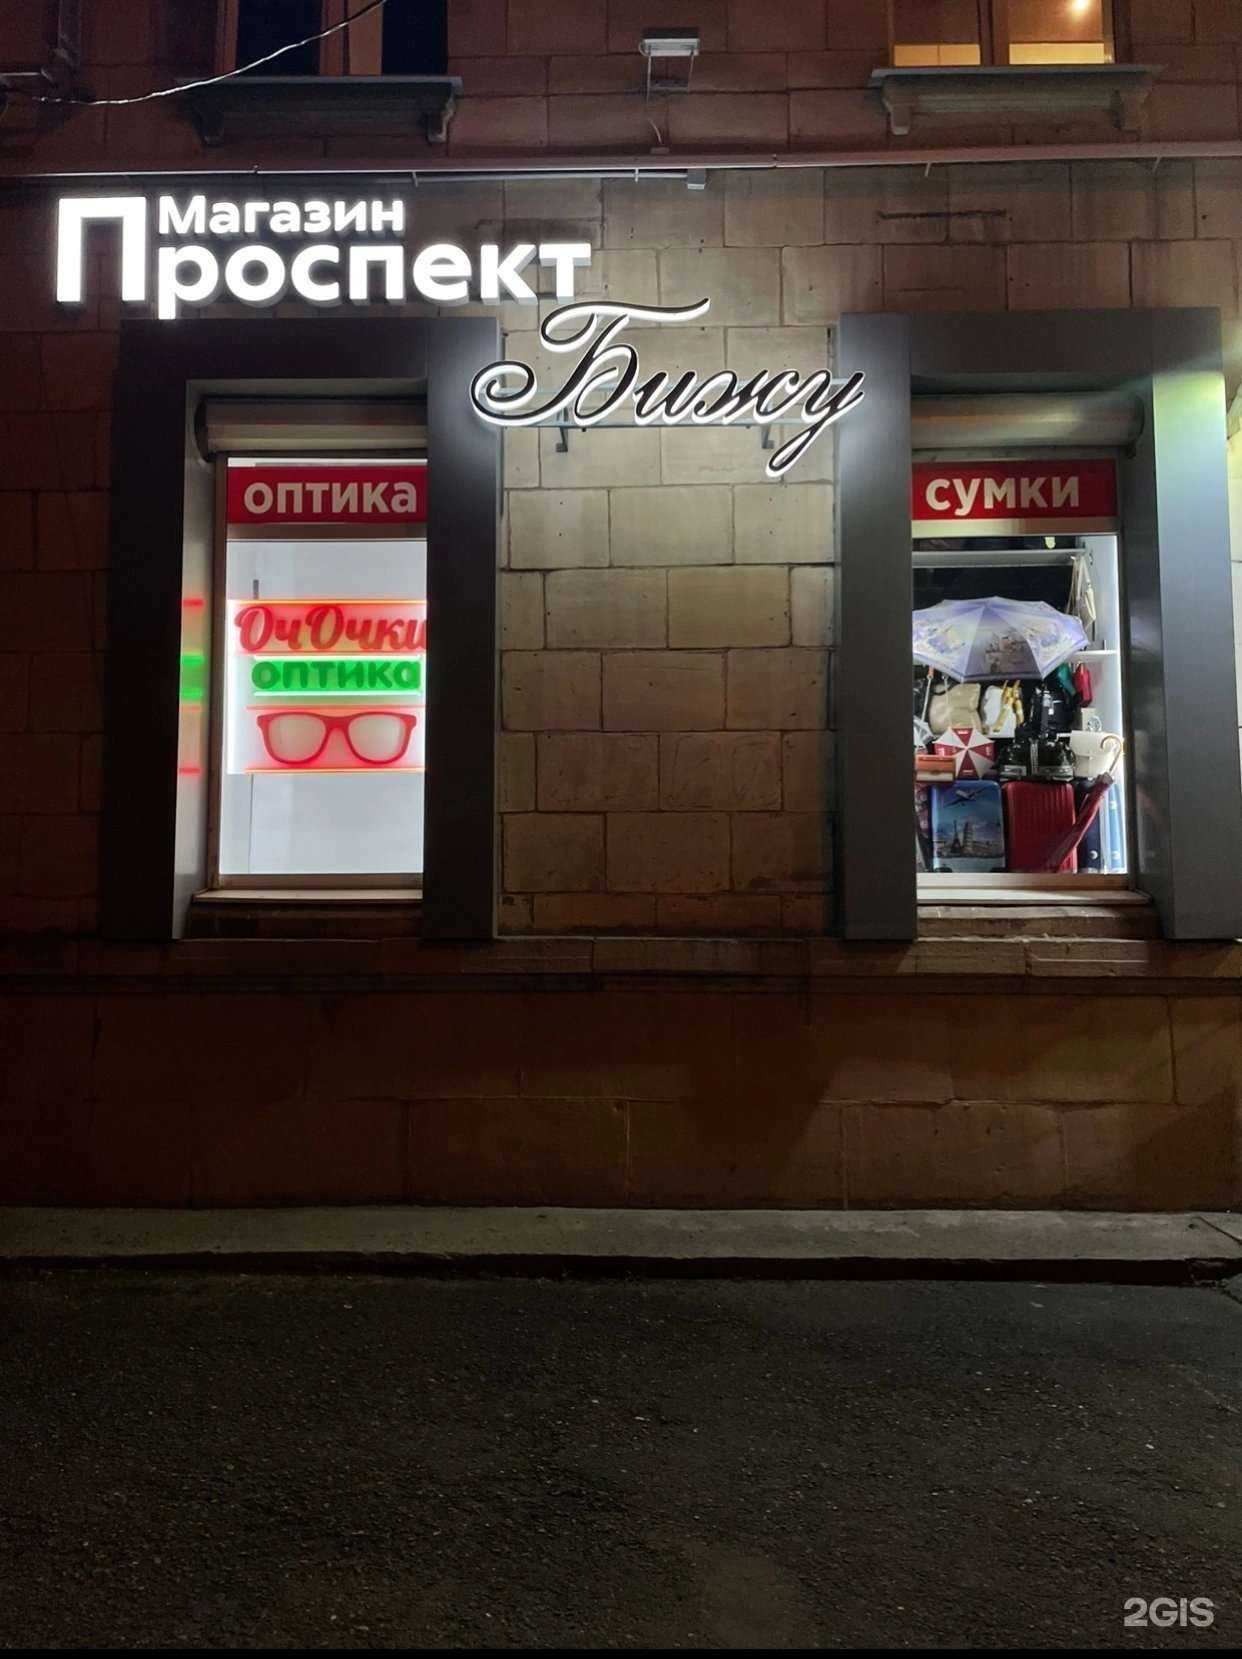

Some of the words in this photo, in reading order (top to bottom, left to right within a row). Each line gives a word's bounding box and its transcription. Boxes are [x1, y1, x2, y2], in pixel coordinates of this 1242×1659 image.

[158, 196, 404, 234] Магазин
[57, 197, 591, 320] Проспект
[470, 298, 865, 477] Бижу
[244, 482, 417, 514] оптика
[926, 476, 1079, 516] сумки
[251, 661, 421, 690] оптика
